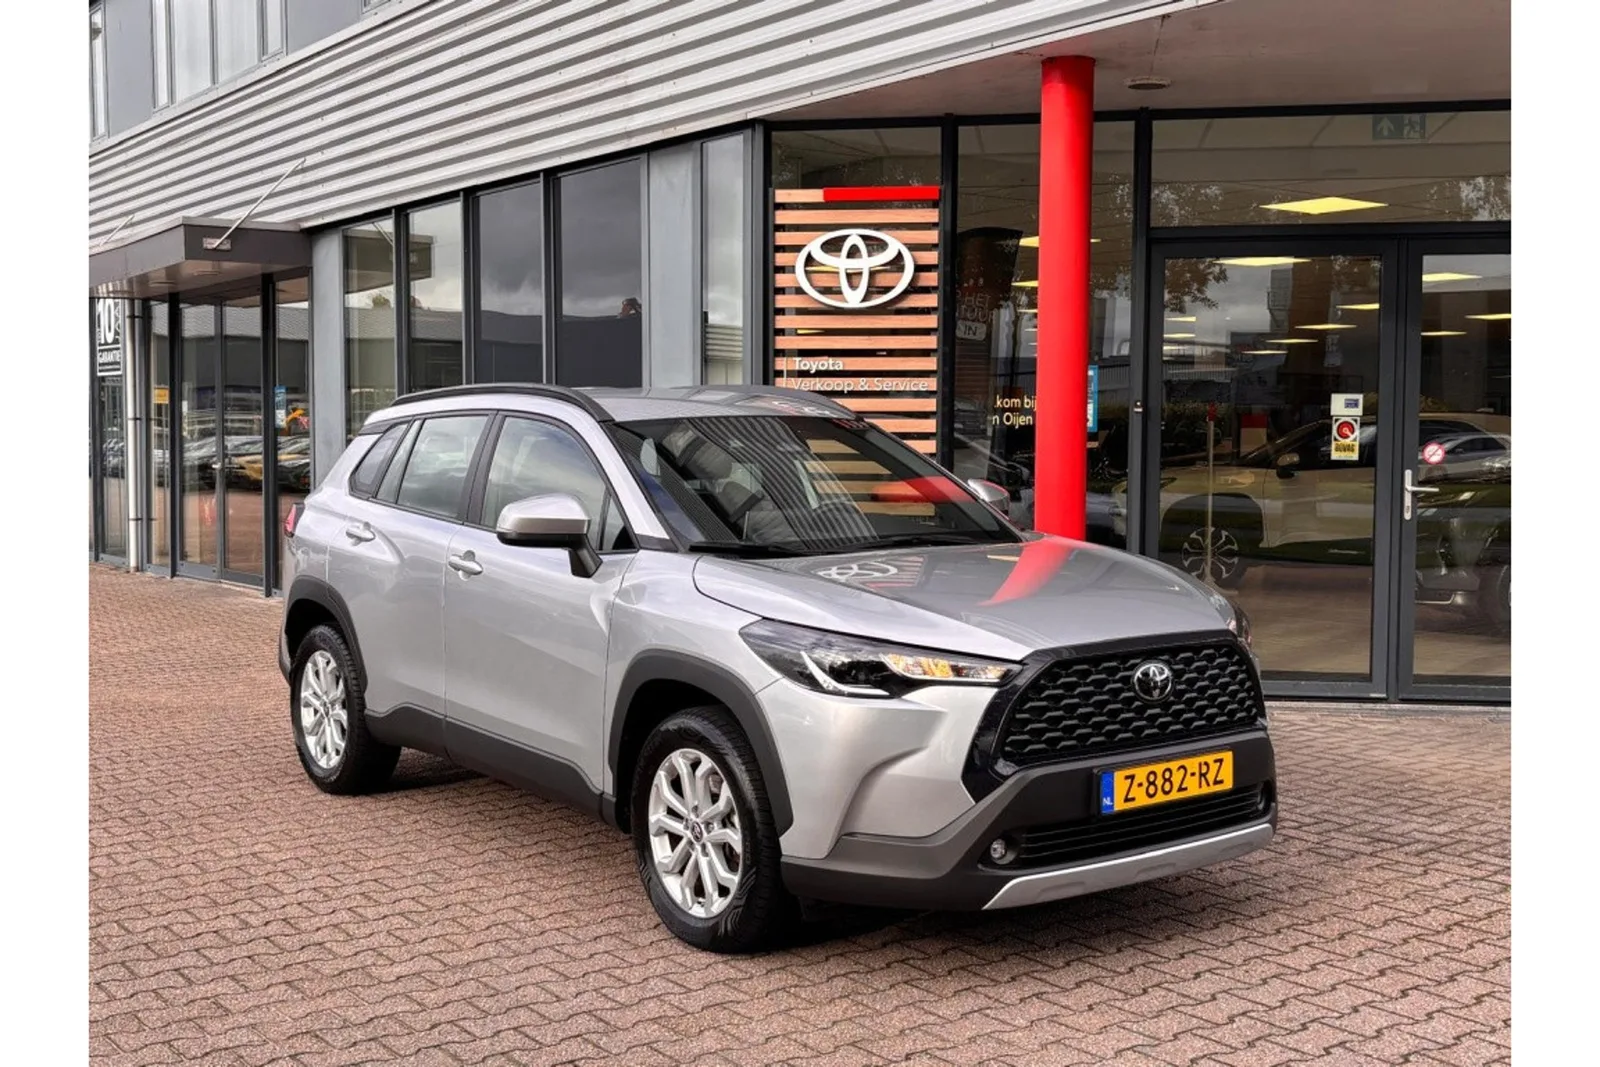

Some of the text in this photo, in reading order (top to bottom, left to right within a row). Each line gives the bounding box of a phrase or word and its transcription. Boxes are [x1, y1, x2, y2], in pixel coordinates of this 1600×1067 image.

[792, 357, 844, 374] Toyota
[791, 377, 929, 394] Verkoop & Service
[1002, 412, 1033, 429] Oijen
[1123, 758, 1225, 804] Z-882-RZ
